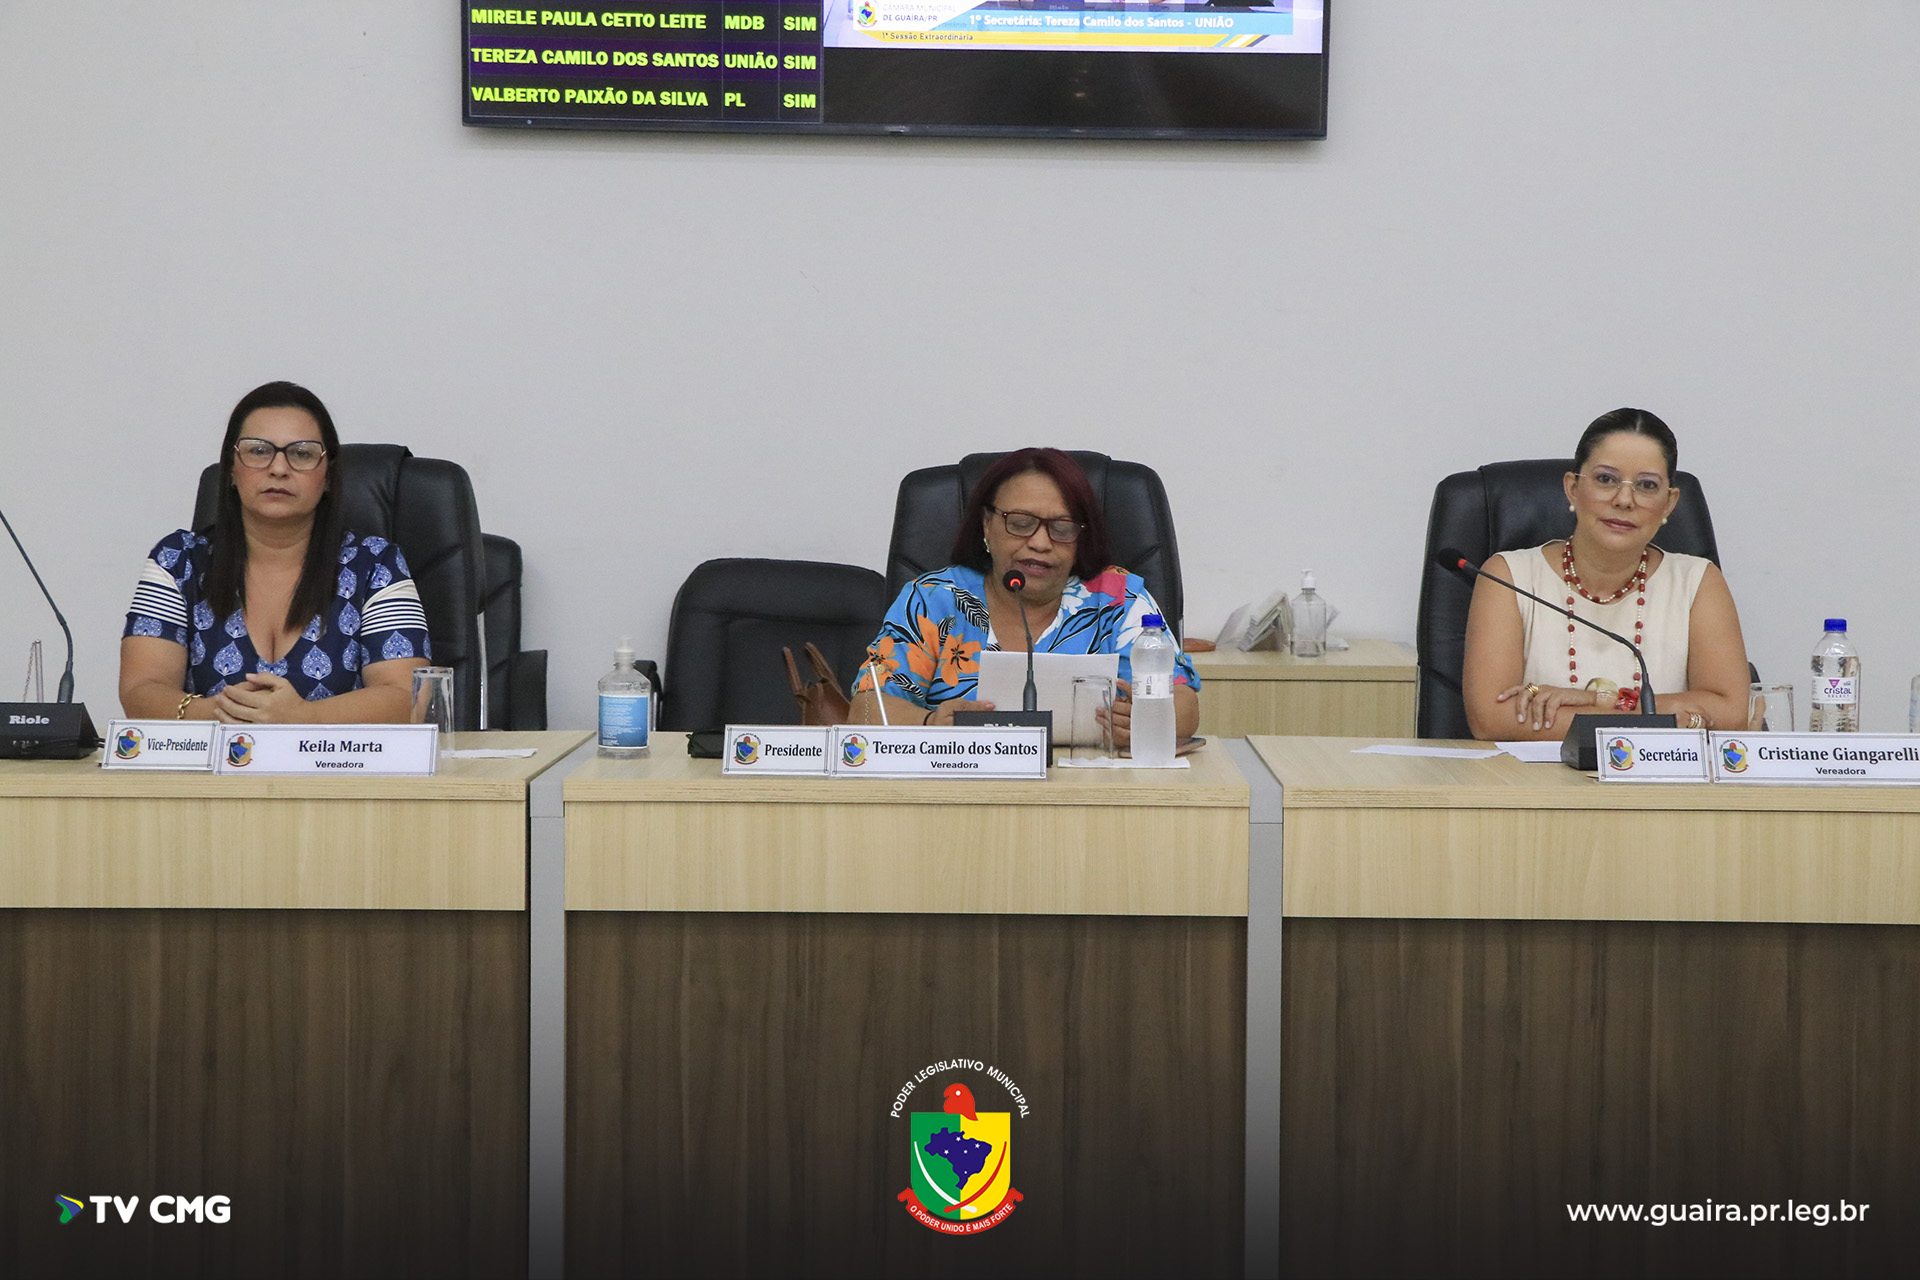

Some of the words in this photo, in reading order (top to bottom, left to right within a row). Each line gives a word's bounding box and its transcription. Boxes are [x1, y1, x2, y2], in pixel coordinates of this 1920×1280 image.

[917, 4, 956, 12] MUNICIPAL
[471, 9, 537, 25] MIRELE
[541, 11, 597, 26] PAULA
[601, 12, 655, 28] CETTO
[659, 13, 706, 29] LEITE
[724, 15, 764, 30] MDB
[784, 16, 816, 31] SIM
[895, 13, 938, 22] GUAÍRA/PR
[984, 15, 1042, 26] Secretária:
[1045, 16, 1080, 26] Tereza
[1083, 16, 1121, 27] Camilo
[1124, 16, 1144, 27] dos
[1147, 17, 1184, 27] Santos
[1195, 16, 1234, 28] UNIÃO
[920, 33, 973, 41] Extraordinária
[471, 48, 537, 64] TEREZA
[542, 50, 608, 65] CAMILO
[613, 51, 648, 66] DOS
[652, 52, 719, 68] SANTOS
[724, 52, 778, 69] UNIÃO
[784, 55, 816, 70] SIM
[471, 87, 560, 103] VALBERTO
[565, 87, 627, 105] PAIXÃO
[632, 91, 656, 105] DA
[660, 91, 708, 106] SILVA
[724, 93, 745, 107] PL
[784, 94, 816, 108] SIM
[9, 714, 50, 725] Riole
[147, 738, 208, 751] Vice-Presidente
[298, 740, 335, 754] Keila
[339, 740, 383, 753] Marta
[764, 743, 823, 758] Presidente
[873, 740, 917, 756] Tereza
[920, 741, 966, 756] Camilo
[968, 741, 992, 755] dos
[994, 742, 1038, 755] Santos
[1639, 748, 1698, 762] Secretária
[1758, 747, 1829, 761] Cristiane
[1833, 748, 1919, 765] Giangarelli
[315, 761, 364, 769] Vereadora
[930, 761, 979, 769] Vereadora
[1816, 767, 1866, 775] Vereadora
